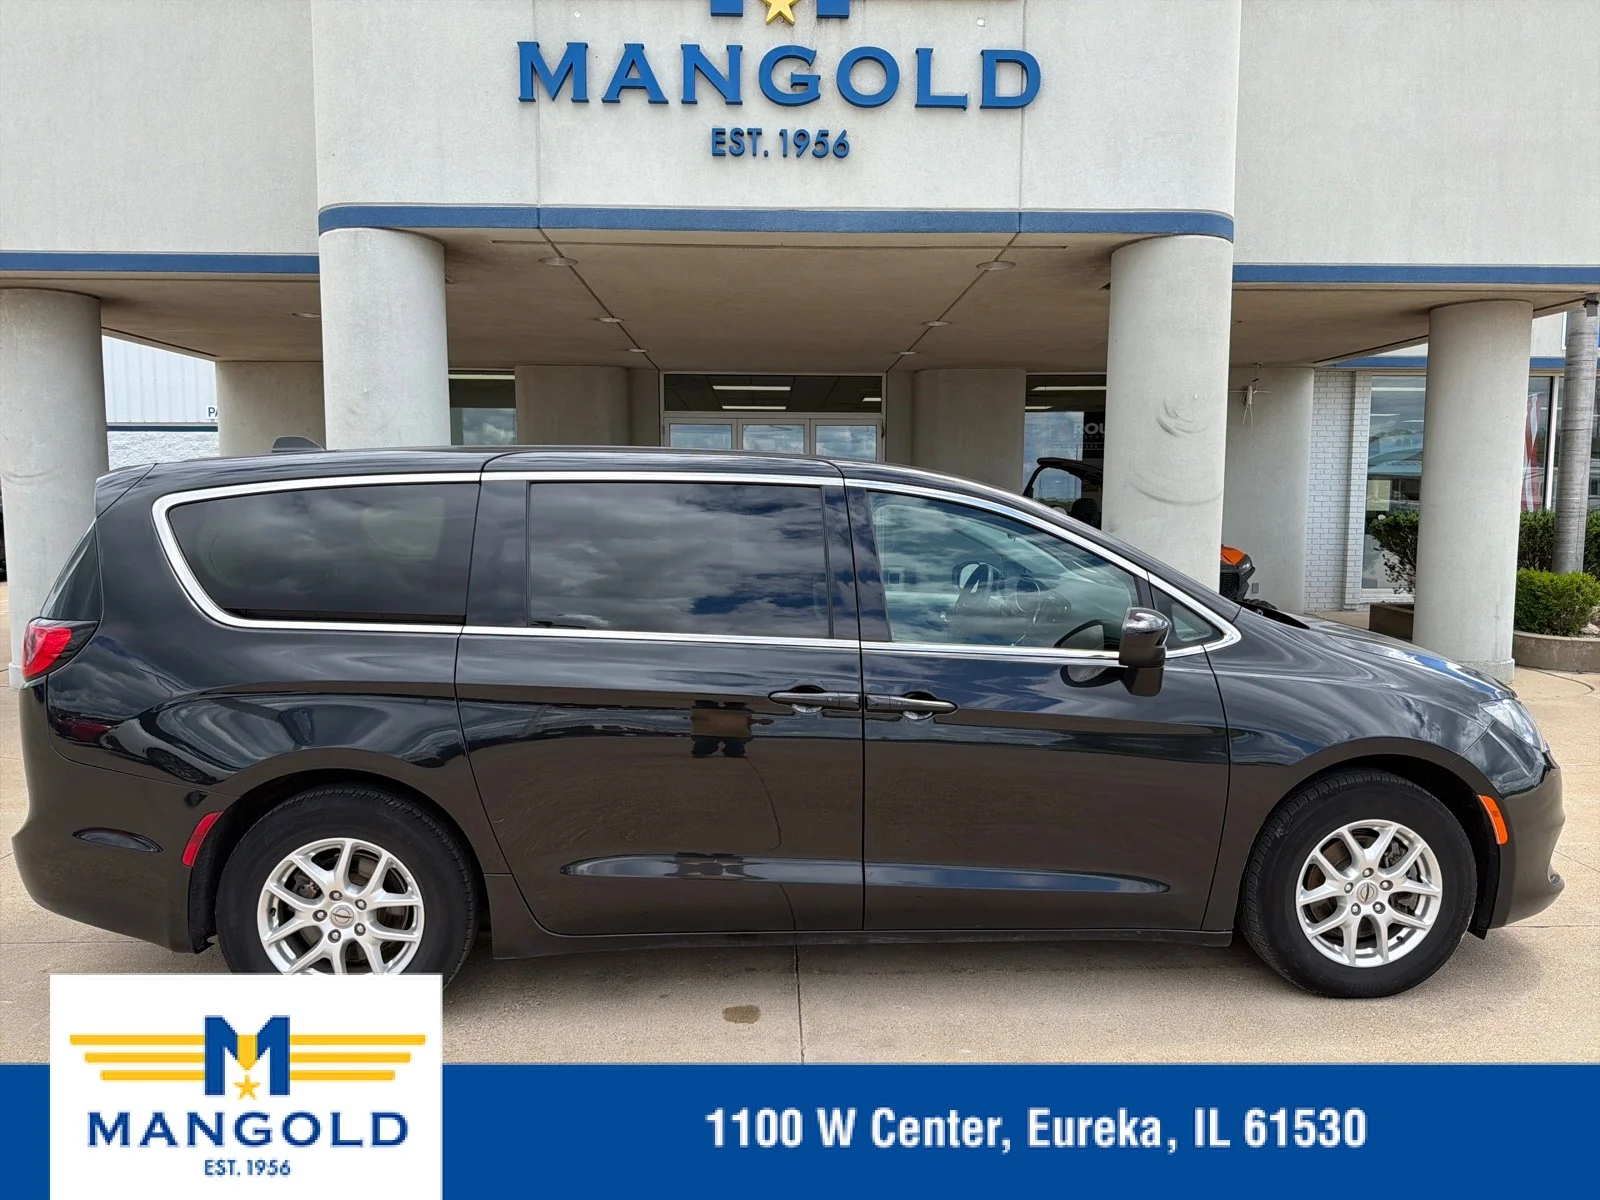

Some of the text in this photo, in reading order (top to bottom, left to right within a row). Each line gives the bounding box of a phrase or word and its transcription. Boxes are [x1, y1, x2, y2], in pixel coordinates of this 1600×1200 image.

[517, 41, 1041, 110] MANGOLD
[711, 127, 850, 158] EST. 1956
